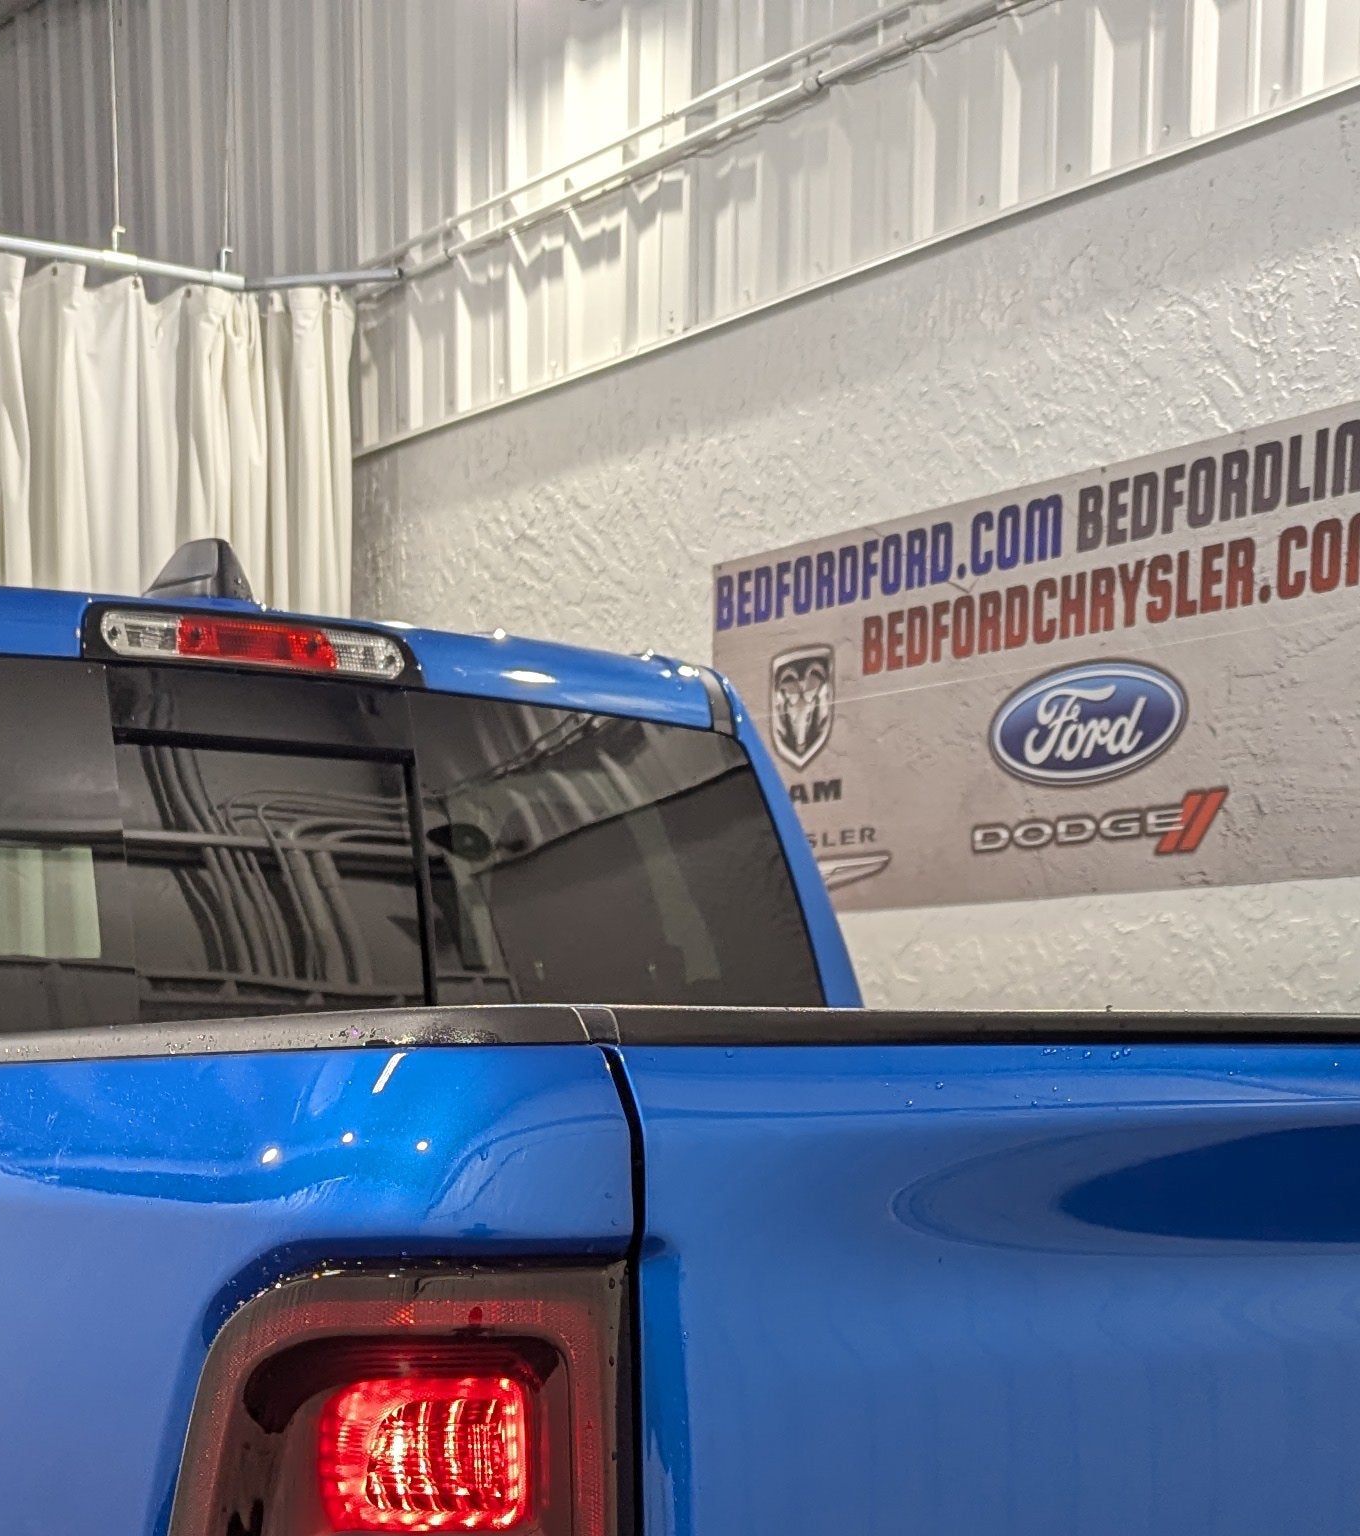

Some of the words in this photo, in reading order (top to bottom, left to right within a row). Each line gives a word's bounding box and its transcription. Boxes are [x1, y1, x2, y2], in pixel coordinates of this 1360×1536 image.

[715, 493, 1063, 632] BEDFORDFORD.COM
[1023, 683, 1145, 767] Ford
[789, 778, 843, 805] AM
[806, 827, 877, 849] SLER
[971, 804, 1189, 855] DODGE
